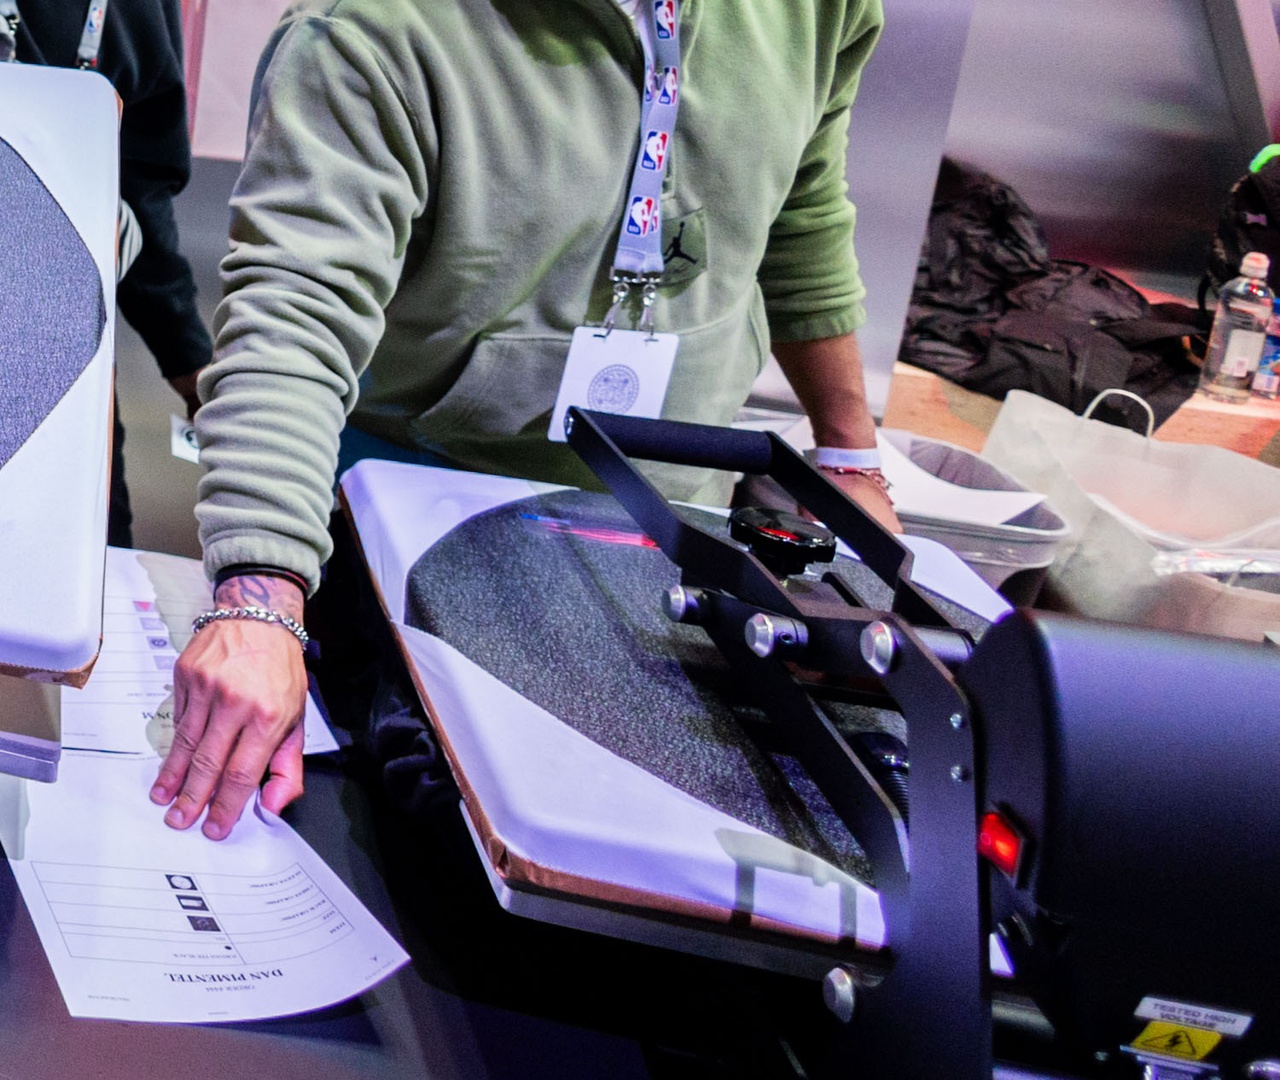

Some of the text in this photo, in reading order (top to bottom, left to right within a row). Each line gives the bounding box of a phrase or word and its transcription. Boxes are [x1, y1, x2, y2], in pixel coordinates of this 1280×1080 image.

[162, 968, 284, 983] DAN PIMENTEL
[1152, 1002, 1201, 1017] TESTED
